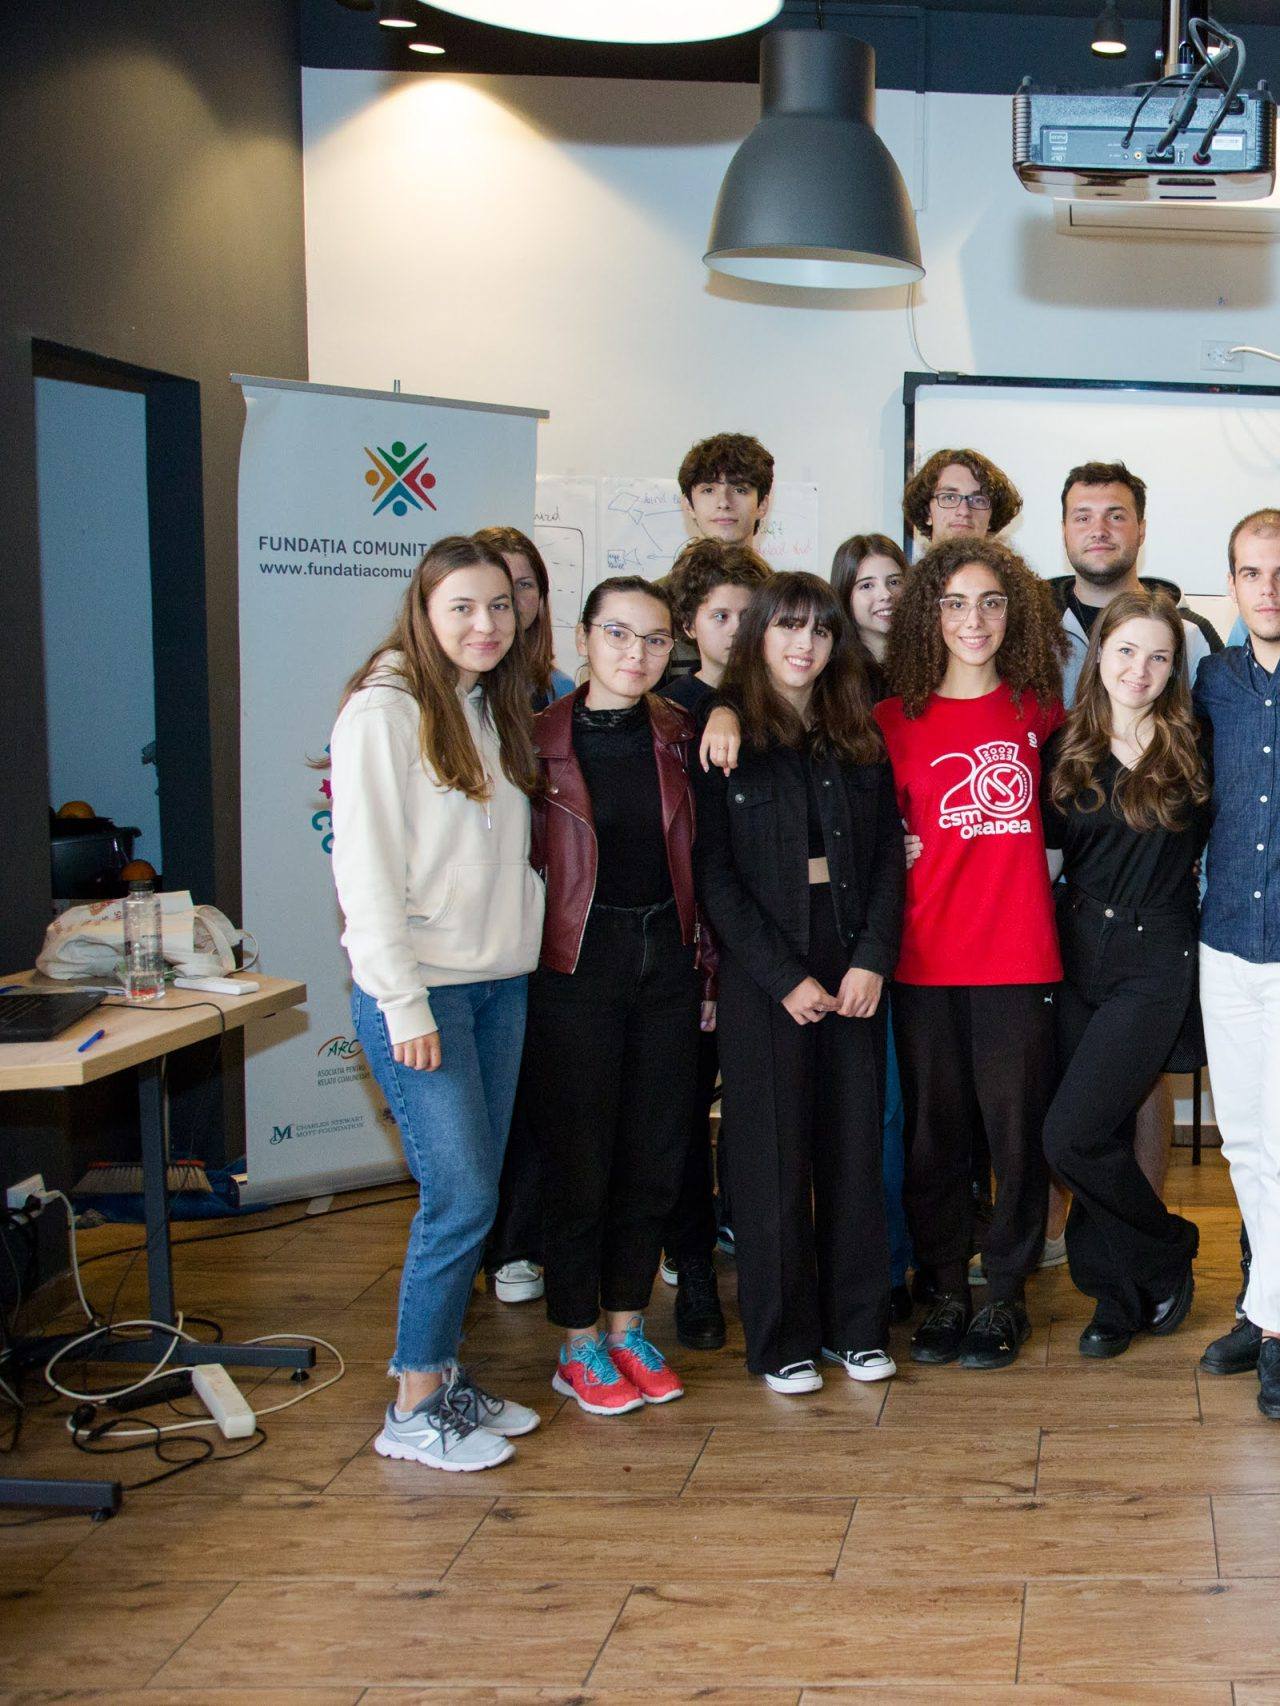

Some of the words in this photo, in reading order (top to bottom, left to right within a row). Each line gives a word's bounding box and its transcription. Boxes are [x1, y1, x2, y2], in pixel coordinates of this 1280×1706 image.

[259, 536, 347, 556] FUNDAȚIA
[353, 540, 427, 557] COMUNIT
[259, 562, 412, 578] www.fundatiacomu
[982, 746, 1013, 758] 2003
[984, 753, 1012, 764] 2023
[328, 1039, 360, 1056] ARC
